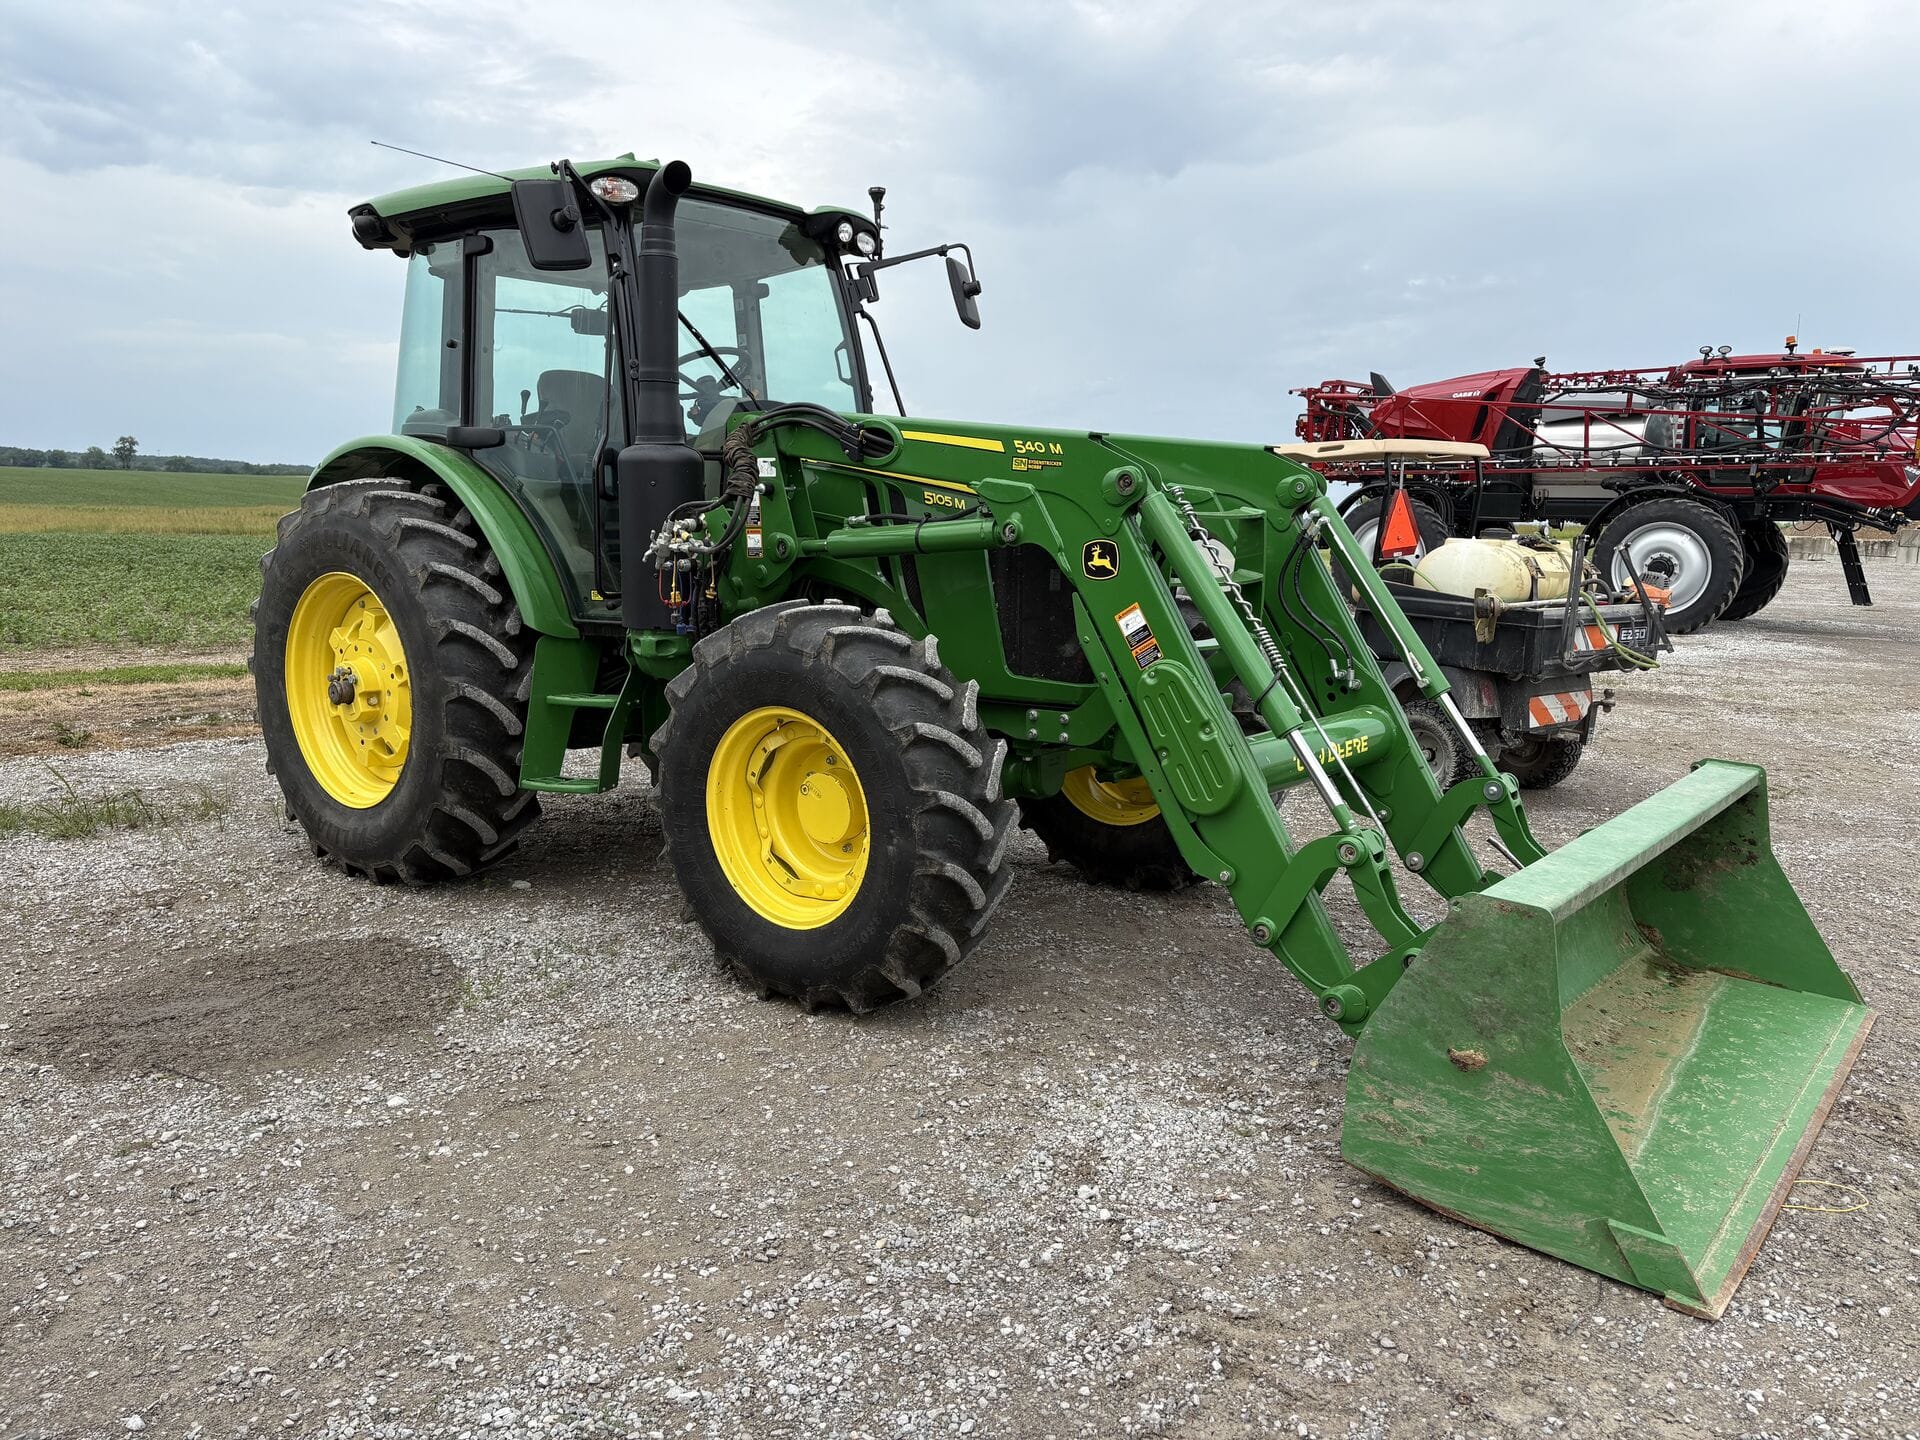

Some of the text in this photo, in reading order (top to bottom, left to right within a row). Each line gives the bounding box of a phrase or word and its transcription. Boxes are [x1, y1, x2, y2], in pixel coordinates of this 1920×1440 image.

[1013, 439, 1064, 455] 540 M
[923, 491, 966, 510] 5105 M
